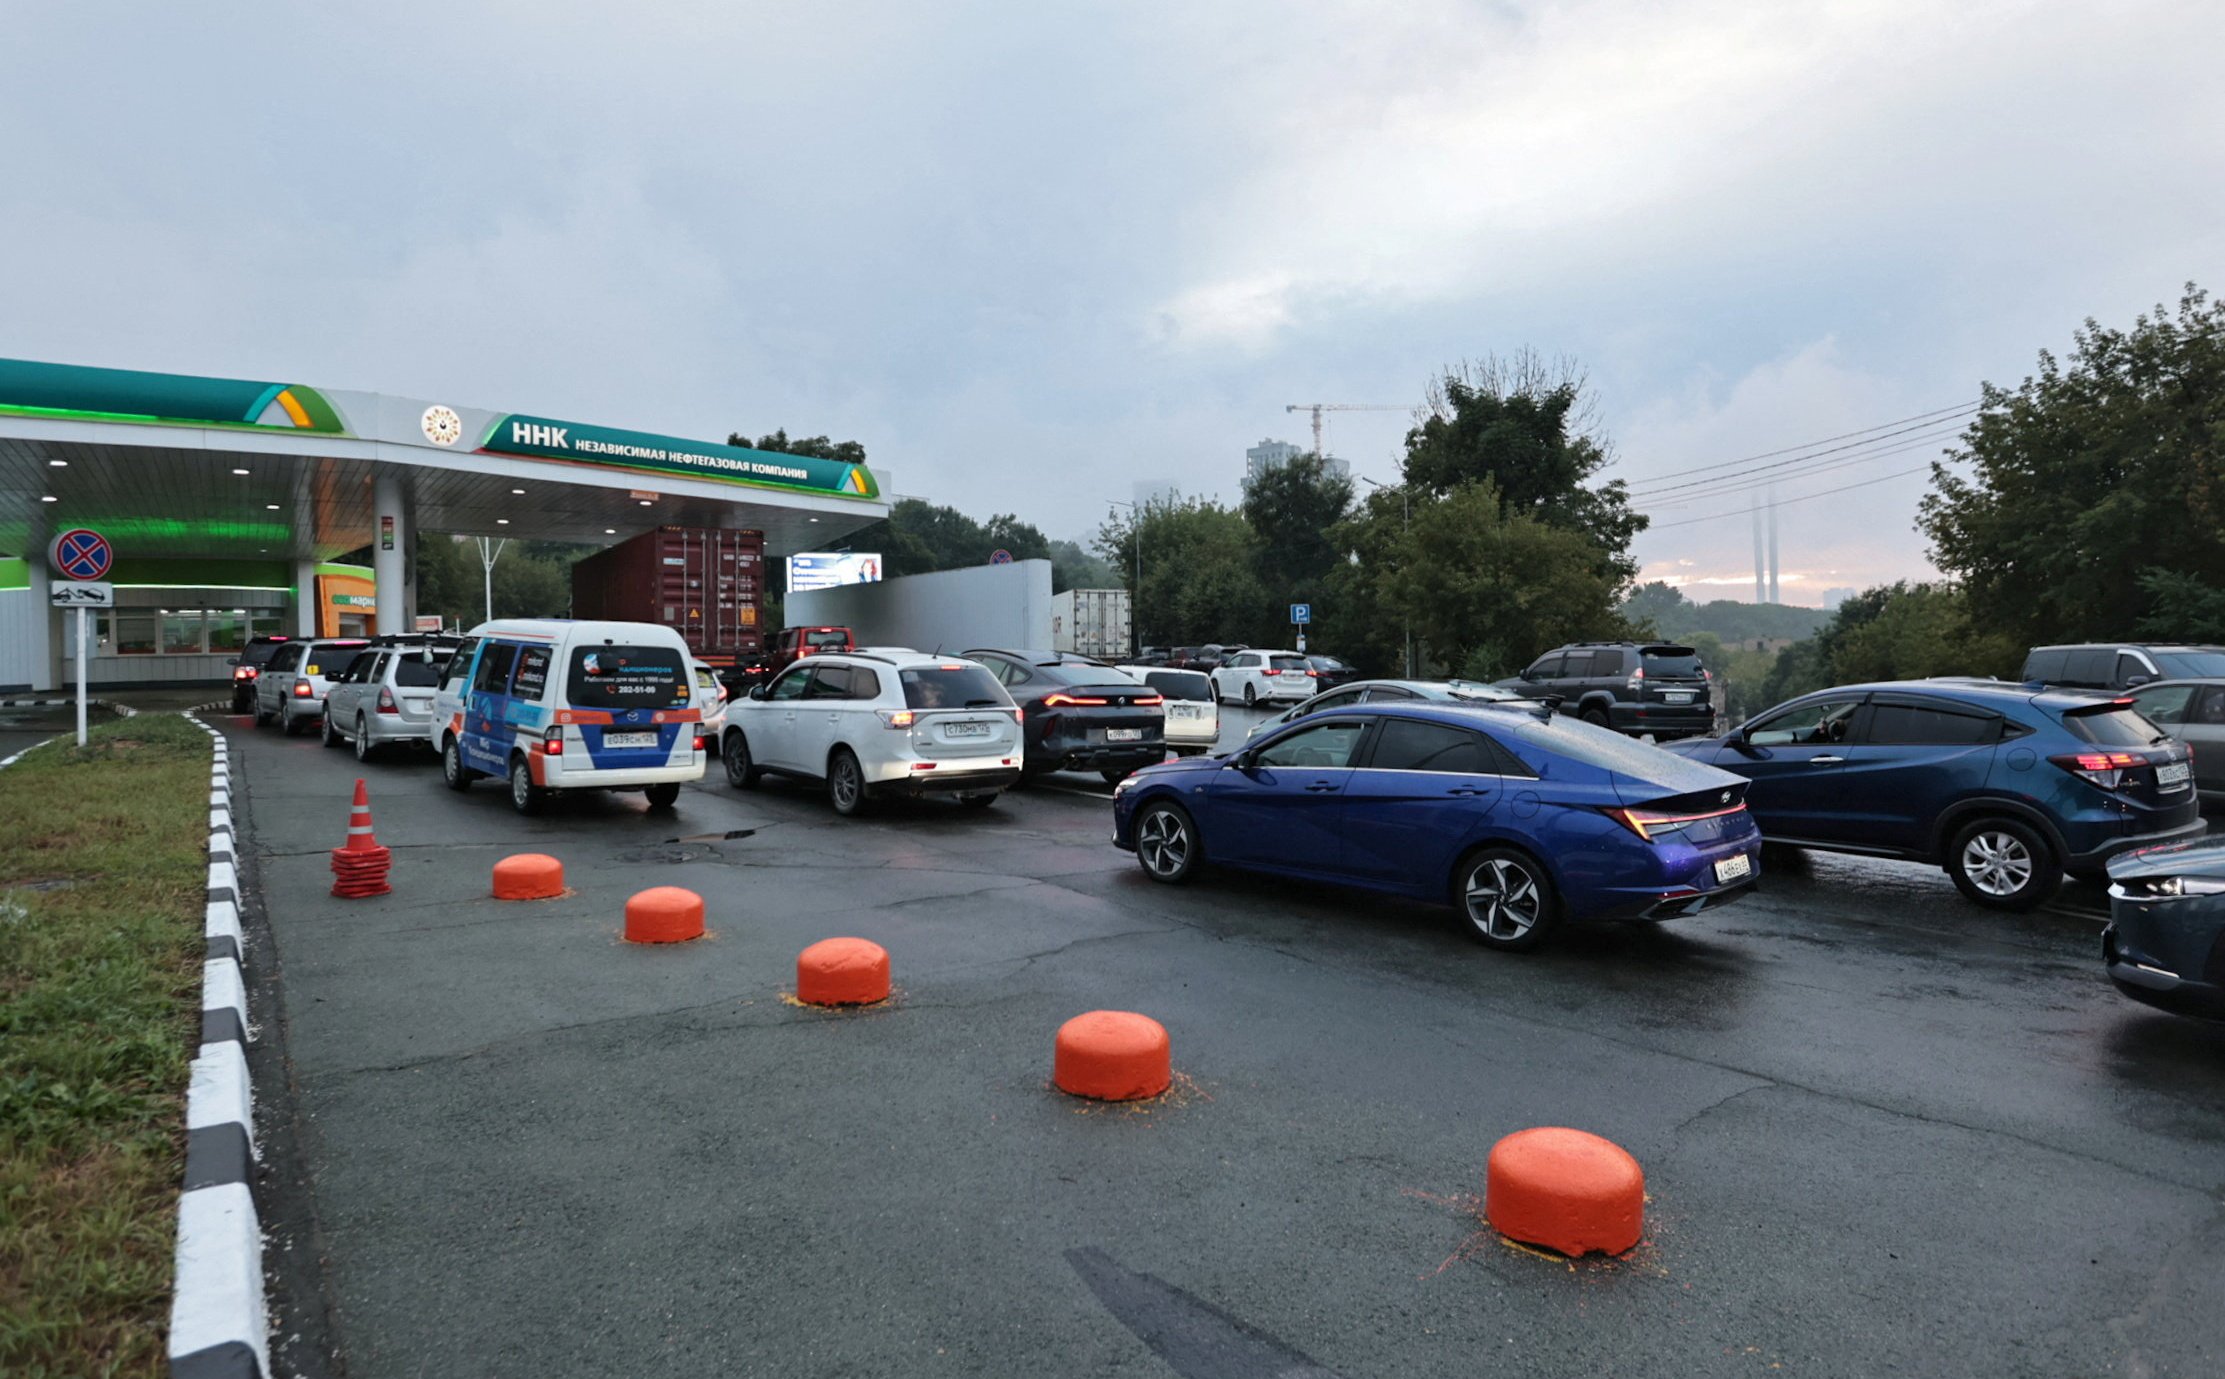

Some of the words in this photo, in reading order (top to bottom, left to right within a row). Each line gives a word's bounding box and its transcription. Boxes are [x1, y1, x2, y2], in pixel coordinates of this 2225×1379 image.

[512, 421, 569, 449] ННК
[575, 439, 667, 461] НЕЗАВИСИМАЯ
[668, 453, 750, 472] НЕФТЕГАЗОВАЯ
[751, 462, 808, 480] КОМПАНИЯ
[1296, 606, 1306, 622] P
